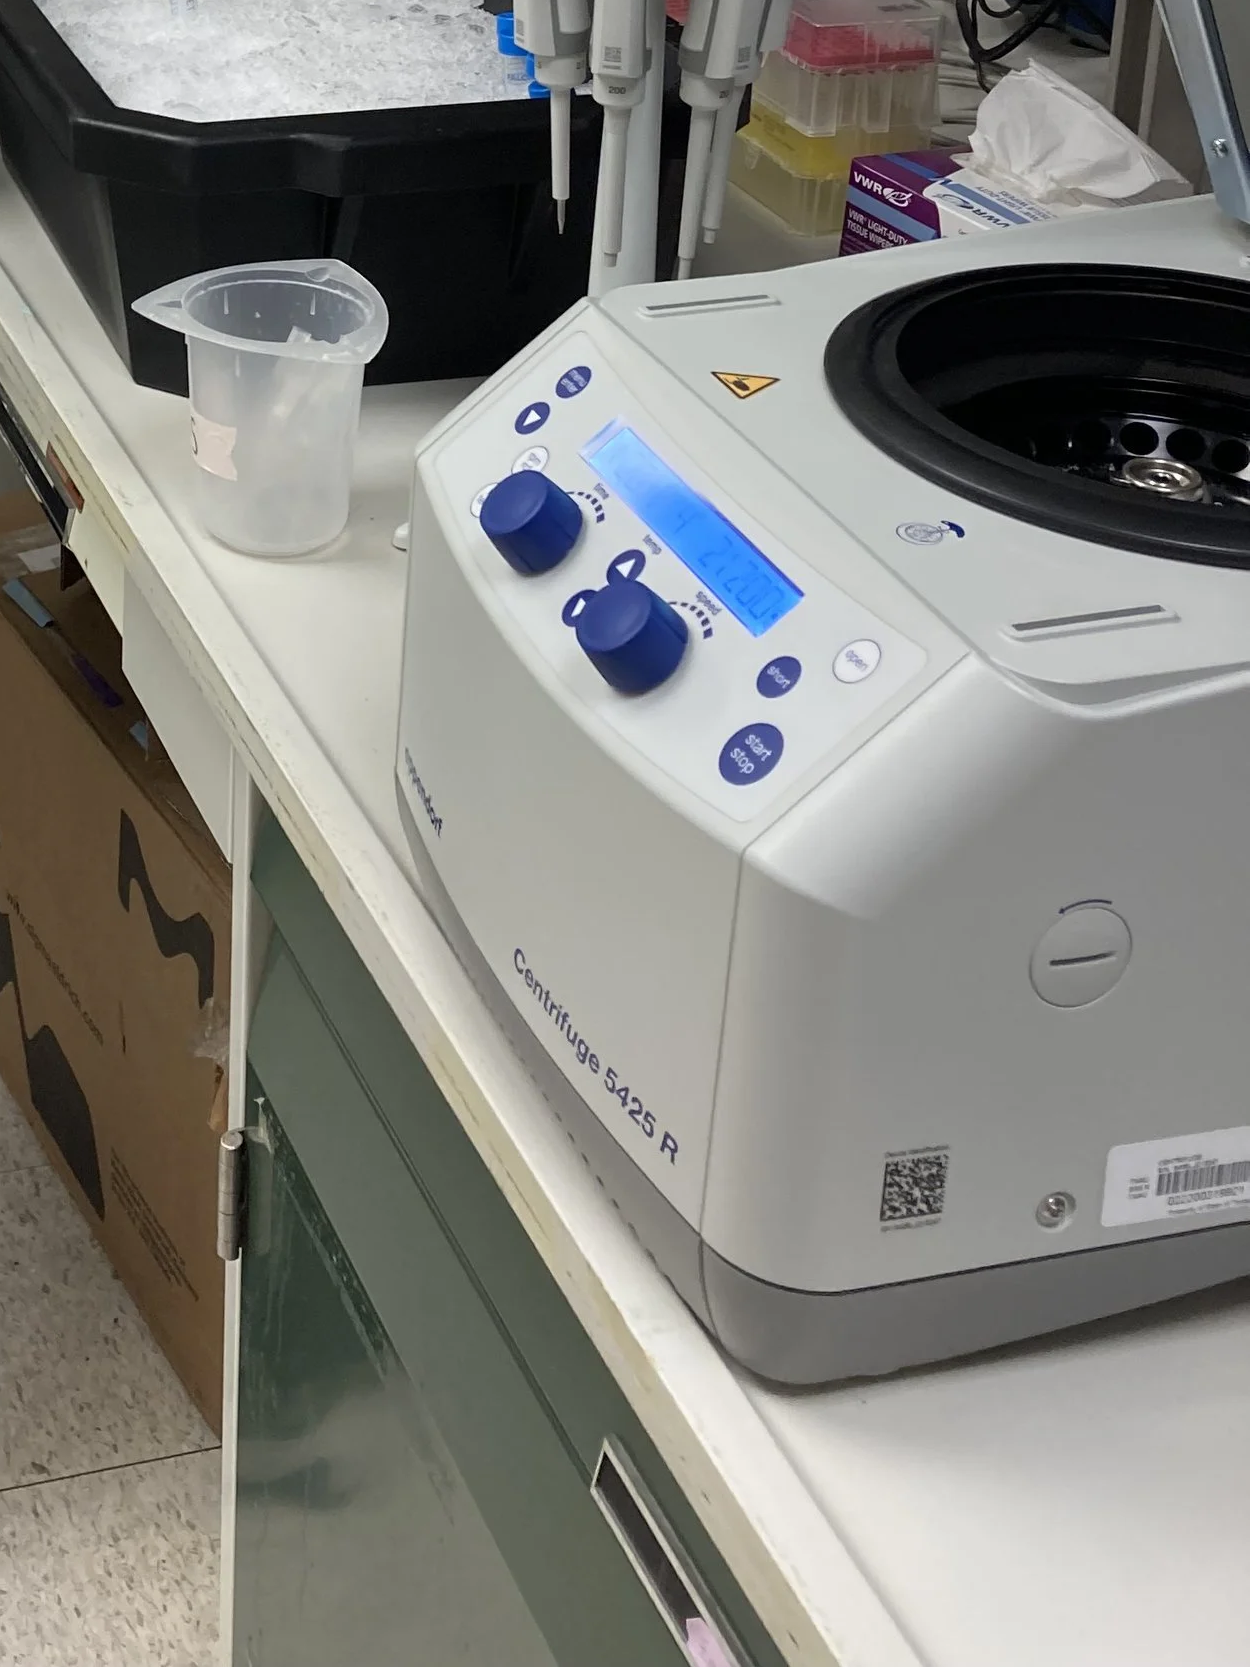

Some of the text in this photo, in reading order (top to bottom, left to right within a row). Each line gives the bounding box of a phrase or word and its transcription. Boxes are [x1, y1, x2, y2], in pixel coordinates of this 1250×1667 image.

[608, 86, 627, 95] 200
[853, 171, 883, 194] VWR
[846, 219, 869, 239] TISSUE
[867, 219, 908, 246] LIGHT-DUTY
[642, 534, 662, 556] temp
[695, 591, 722, 616] speed
[845, 650, 870, 672] open
[767, 665, 791, 689] short
[745, 734, 772, 762] start
[730, 747, 755, 774] stop
[513, 947, 679, 1165] Centrifuge 5425 R
